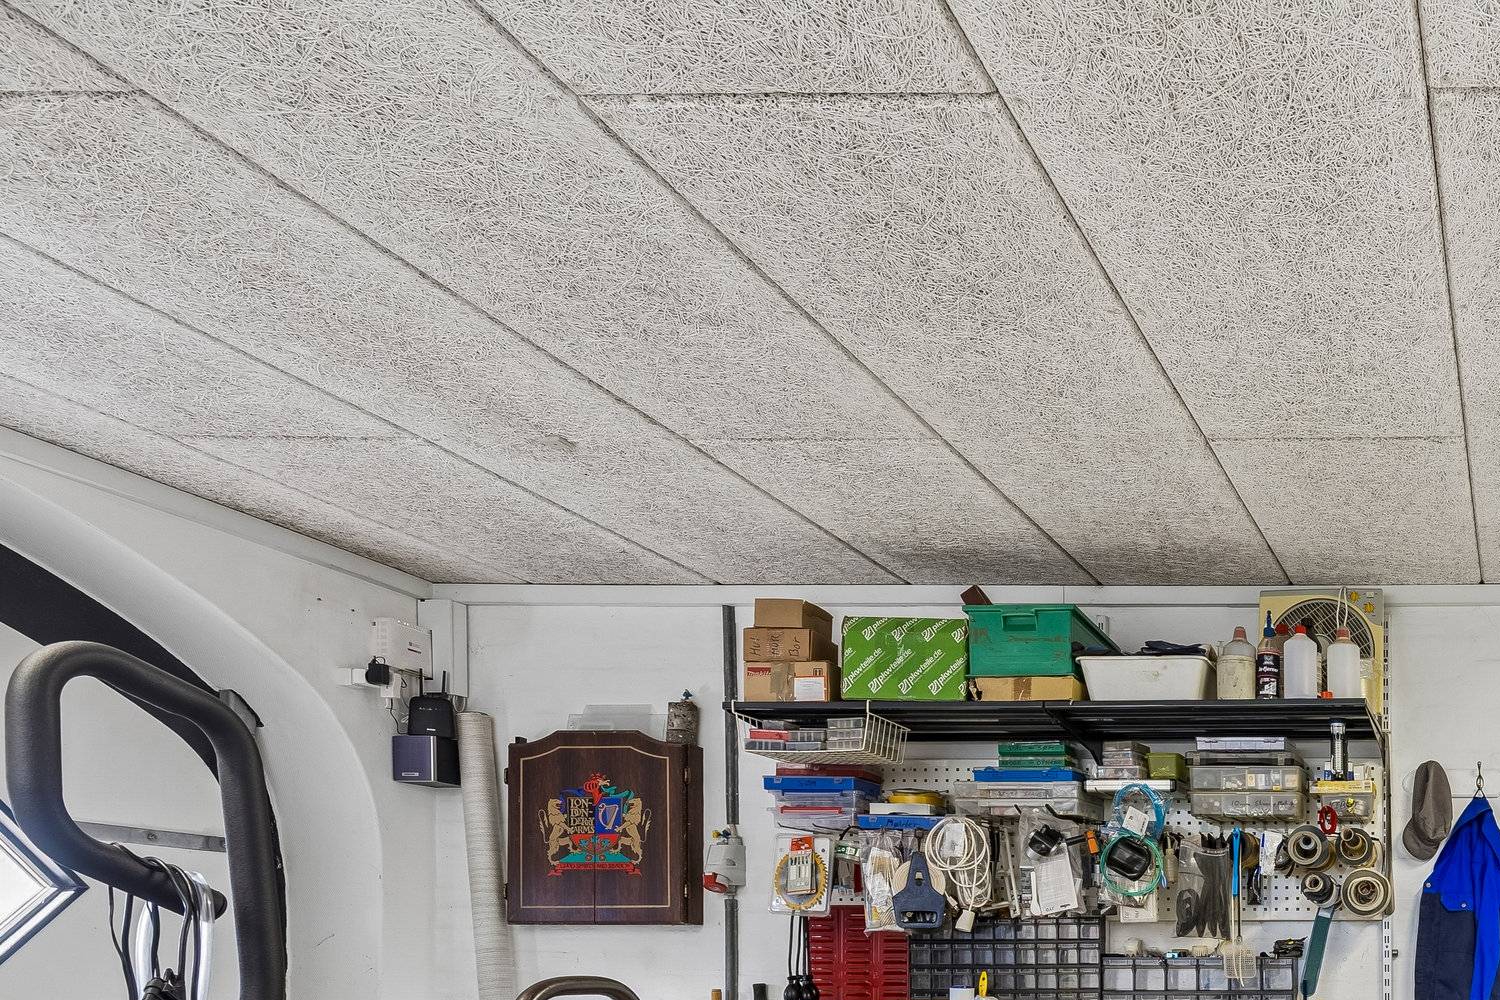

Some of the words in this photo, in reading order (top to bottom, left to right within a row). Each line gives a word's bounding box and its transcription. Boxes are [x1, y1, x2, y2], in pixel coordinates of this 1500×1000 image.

[848, 647, 883, 684] pkwteile.de
[878, 648, 913, 685] pkwteile.de
[908, 648, 943, 686] pkwteile.de
[938, 652, 968, 687] pkwteile.d
